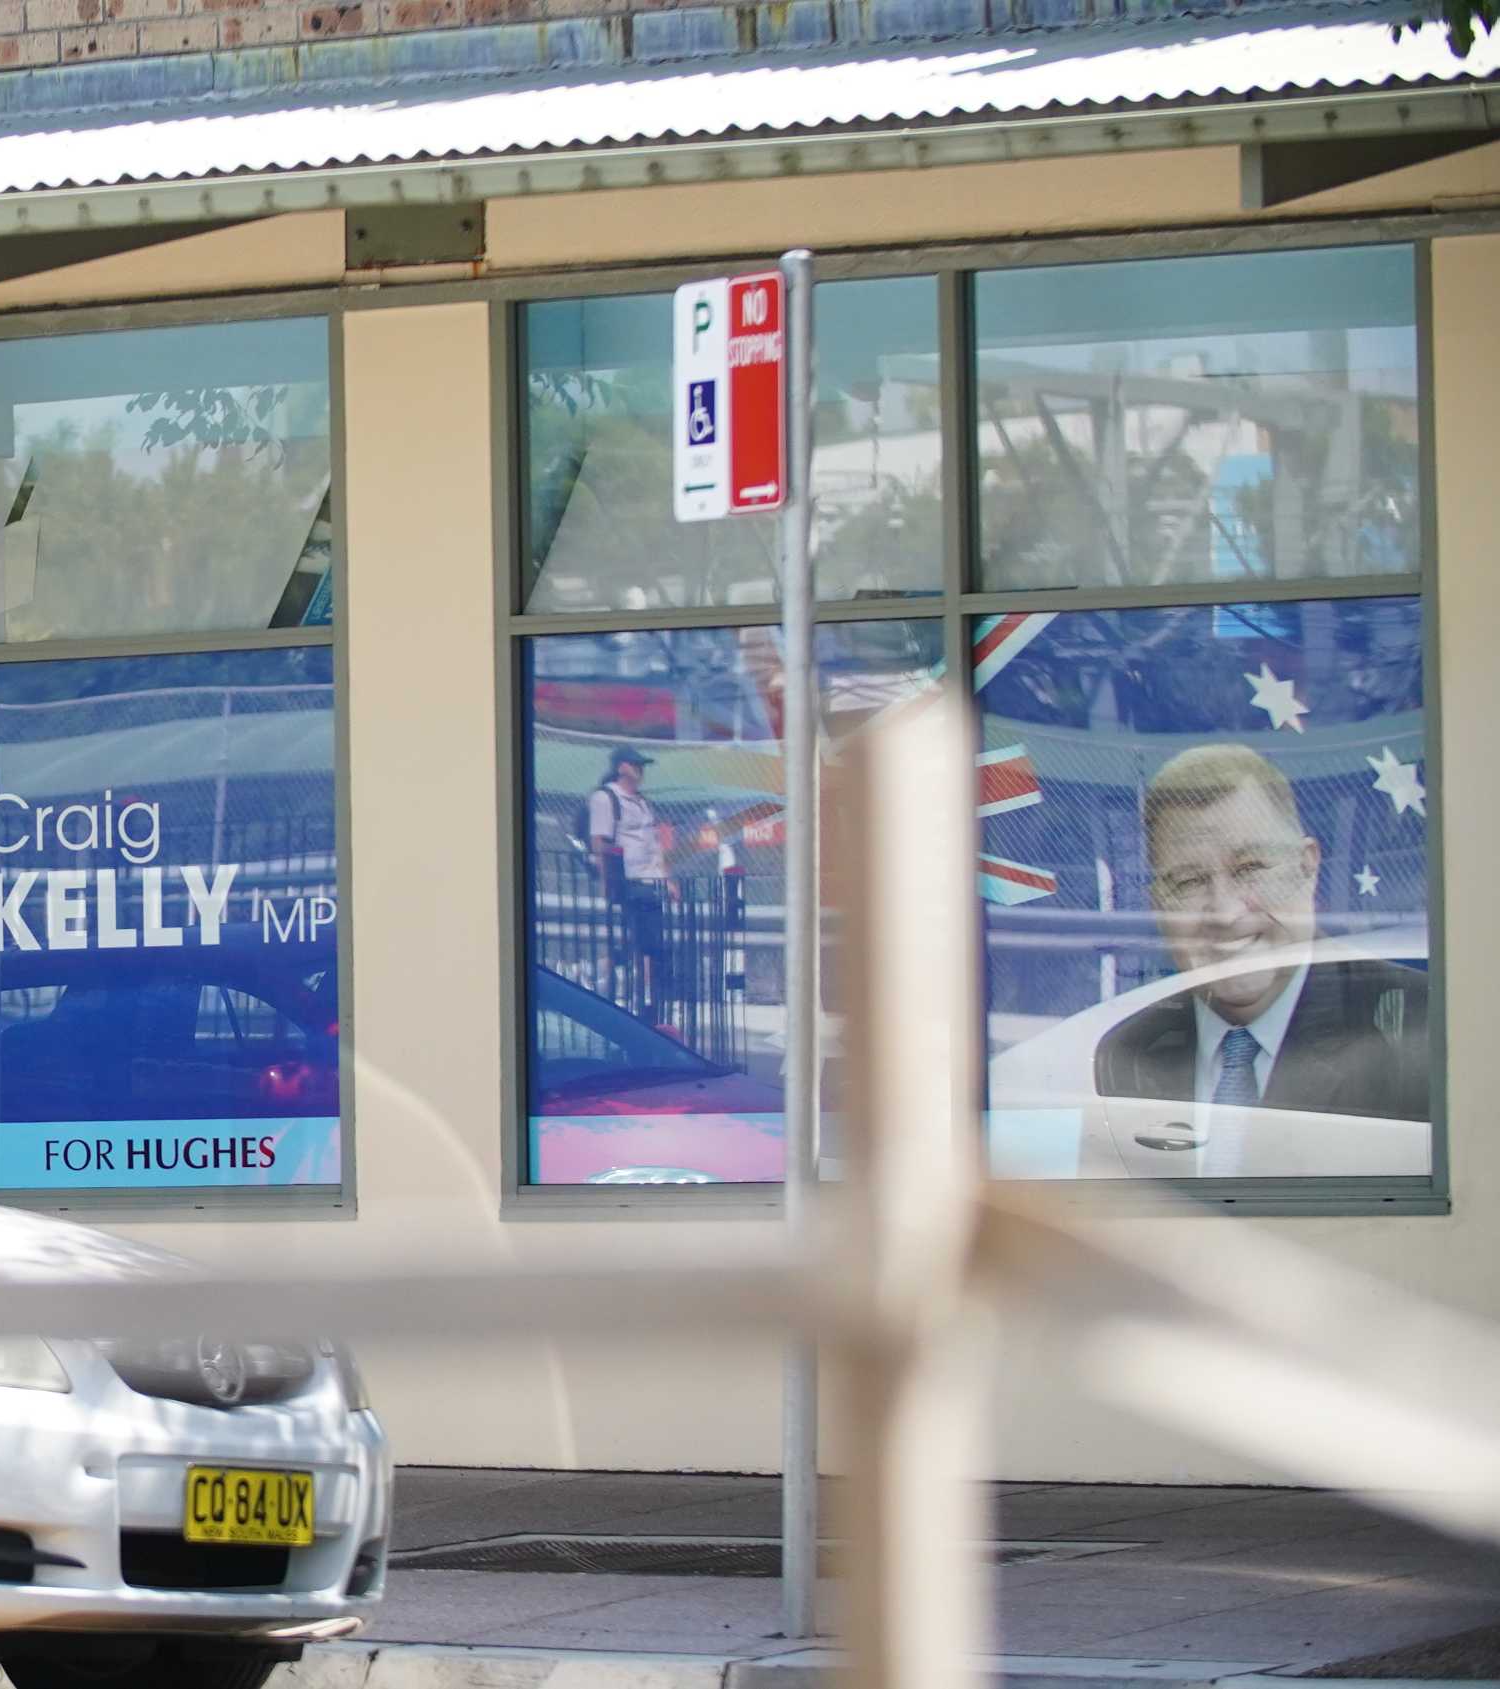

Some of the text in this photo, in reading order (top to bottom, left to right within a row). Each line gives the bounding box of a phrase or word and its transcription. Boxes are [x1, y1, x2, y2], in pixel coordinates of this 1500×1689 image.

[692, 300, 711, 354] P
[742, 287, 768, 327] NO
[728, 331, 782, 368] STOPPING
[263, 897, 337, 943] MP
[45, 1139, 115, 1171] FOR
[127, 1136, 276, 1170] HUGHES
